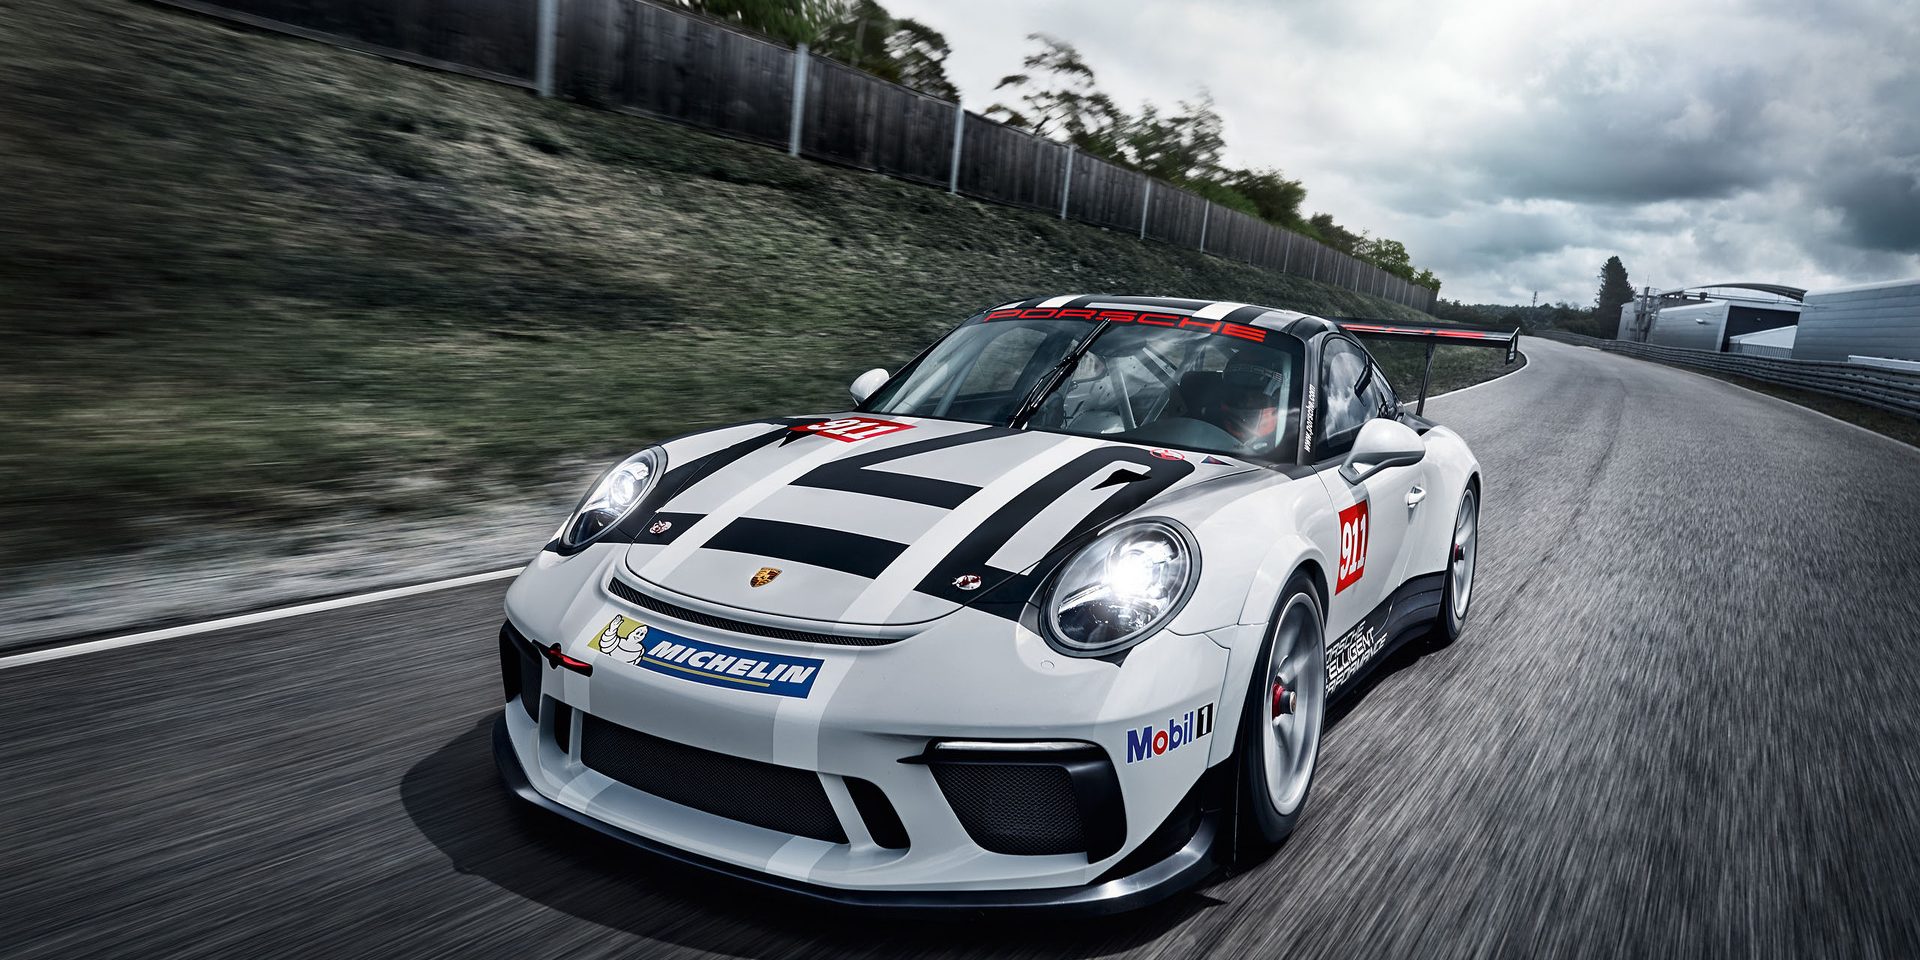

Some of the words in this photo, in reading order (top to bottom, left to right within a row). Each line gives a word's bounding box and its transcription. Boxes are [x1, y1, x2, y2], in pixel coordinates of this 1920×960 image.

[984, 308, 1267, 343] PORSCHE
[807, 419, 900, 440] 911
[1304, 383, 1316, 453] www.porsche.com
[1340, 513, 1366, 581] 911
[648, 640, 816, 684] MICHELIN
[1126, 711, 1194, 764] Mobil
